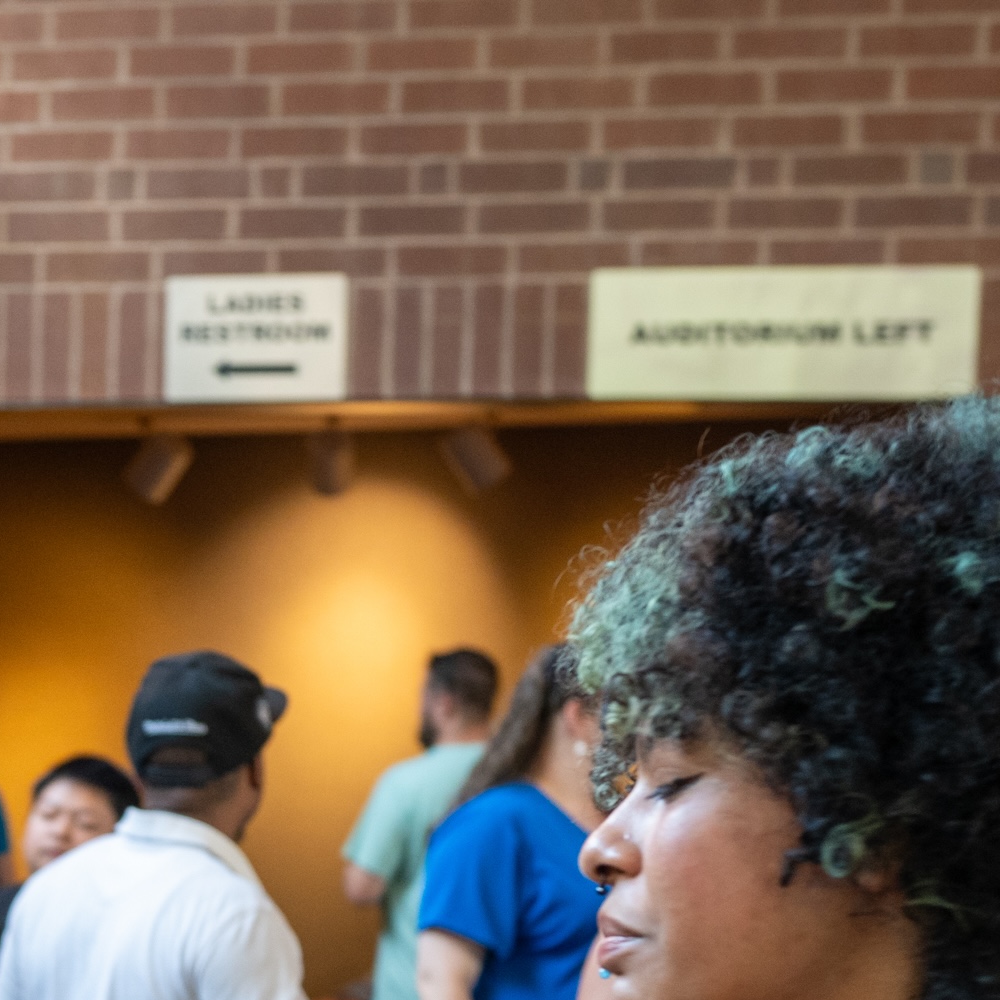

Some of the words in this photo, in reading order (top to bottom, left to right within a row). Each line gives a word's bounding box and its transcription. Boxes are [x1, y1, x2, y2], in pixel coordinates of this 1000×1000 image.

[206, 294, 304, 313] LADIES
[180, 322, 331, 344] RESTROOM
[631, 321, 843, 346] AUDITORIUM
[852, 319, 935, 345] LEFT
